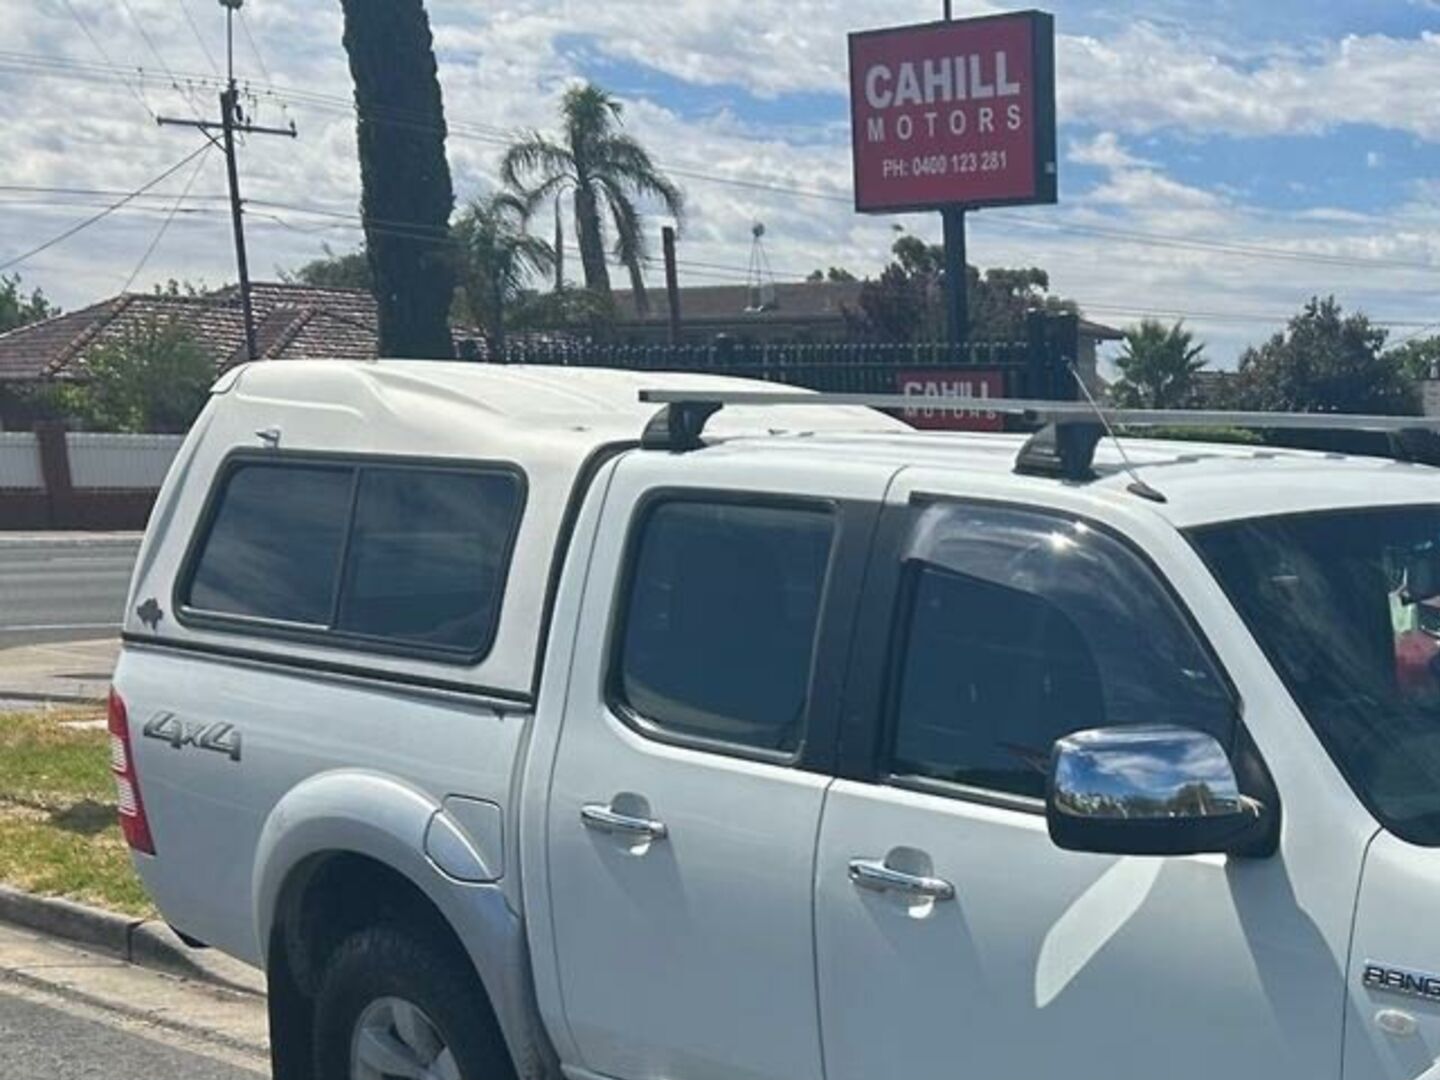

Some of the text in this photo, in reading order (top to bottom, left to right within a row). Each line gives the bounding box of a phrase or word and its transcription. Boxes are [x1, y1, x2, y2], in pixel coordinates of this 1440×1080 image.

[865, 51, 1021, 109] CAHILL
[867, 104, 1021, 142] MOTORS
[912, 155, 947, 175] 0400
[951, 152, 978, 173] 123
[981, 150, 1008, 171] 281
